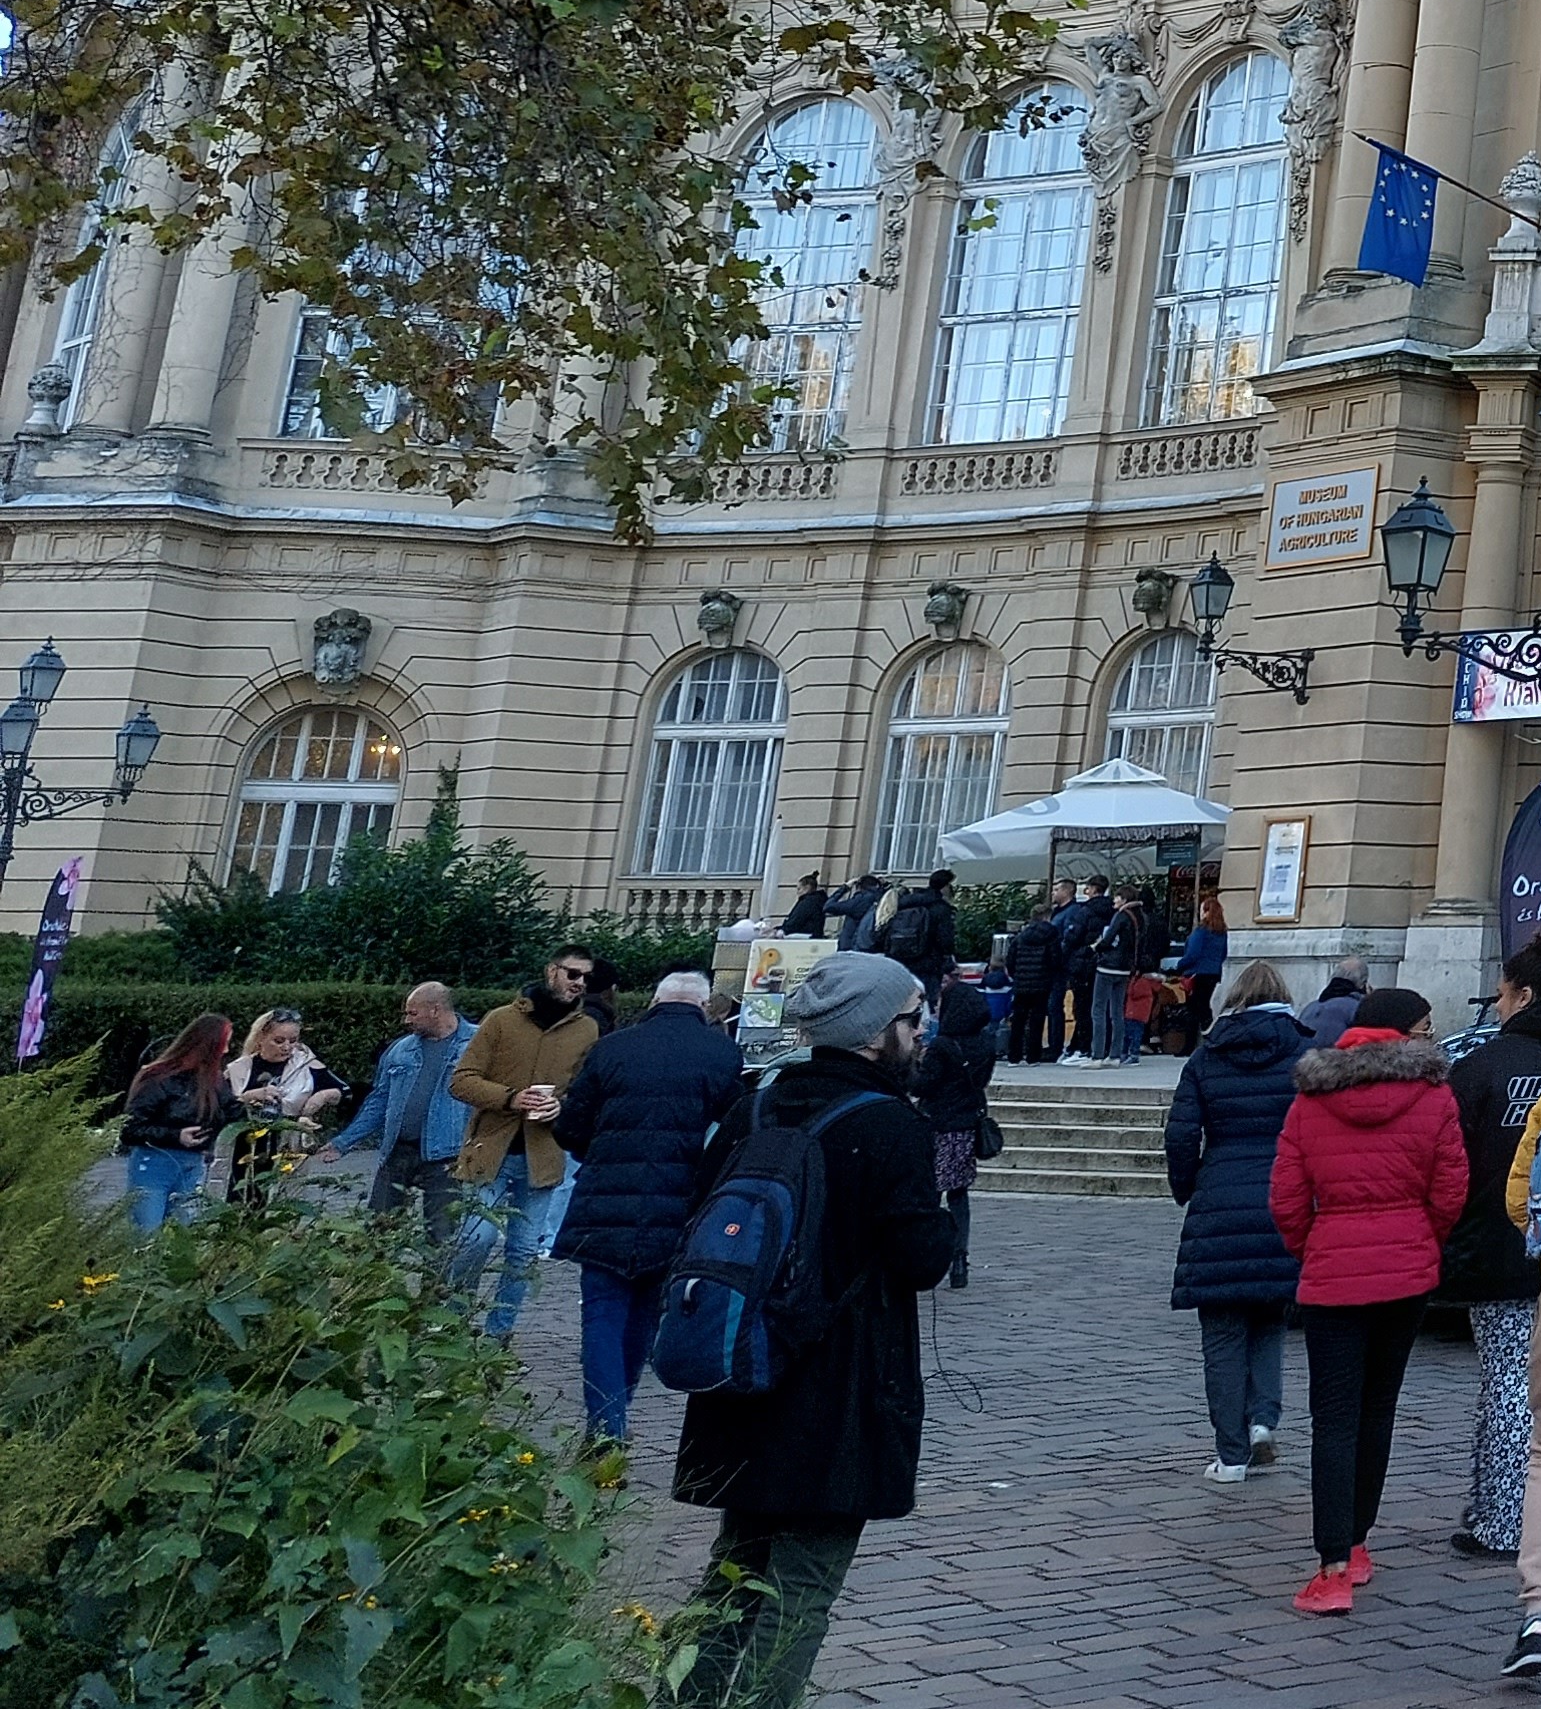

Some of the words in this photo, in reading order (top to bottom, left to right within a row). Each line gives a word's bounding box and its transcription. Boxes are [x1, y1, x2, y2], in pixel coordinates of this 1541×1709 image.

[1299, 484, 1348, 505] MUSEUM
[1279, 515, 1295, 530] OF
[1297, 504, 1364, 528] HUNGARIAN
[1278, 528, 1359, 552] AGRICULTURE
[1517, 908, 1533, 922] és
